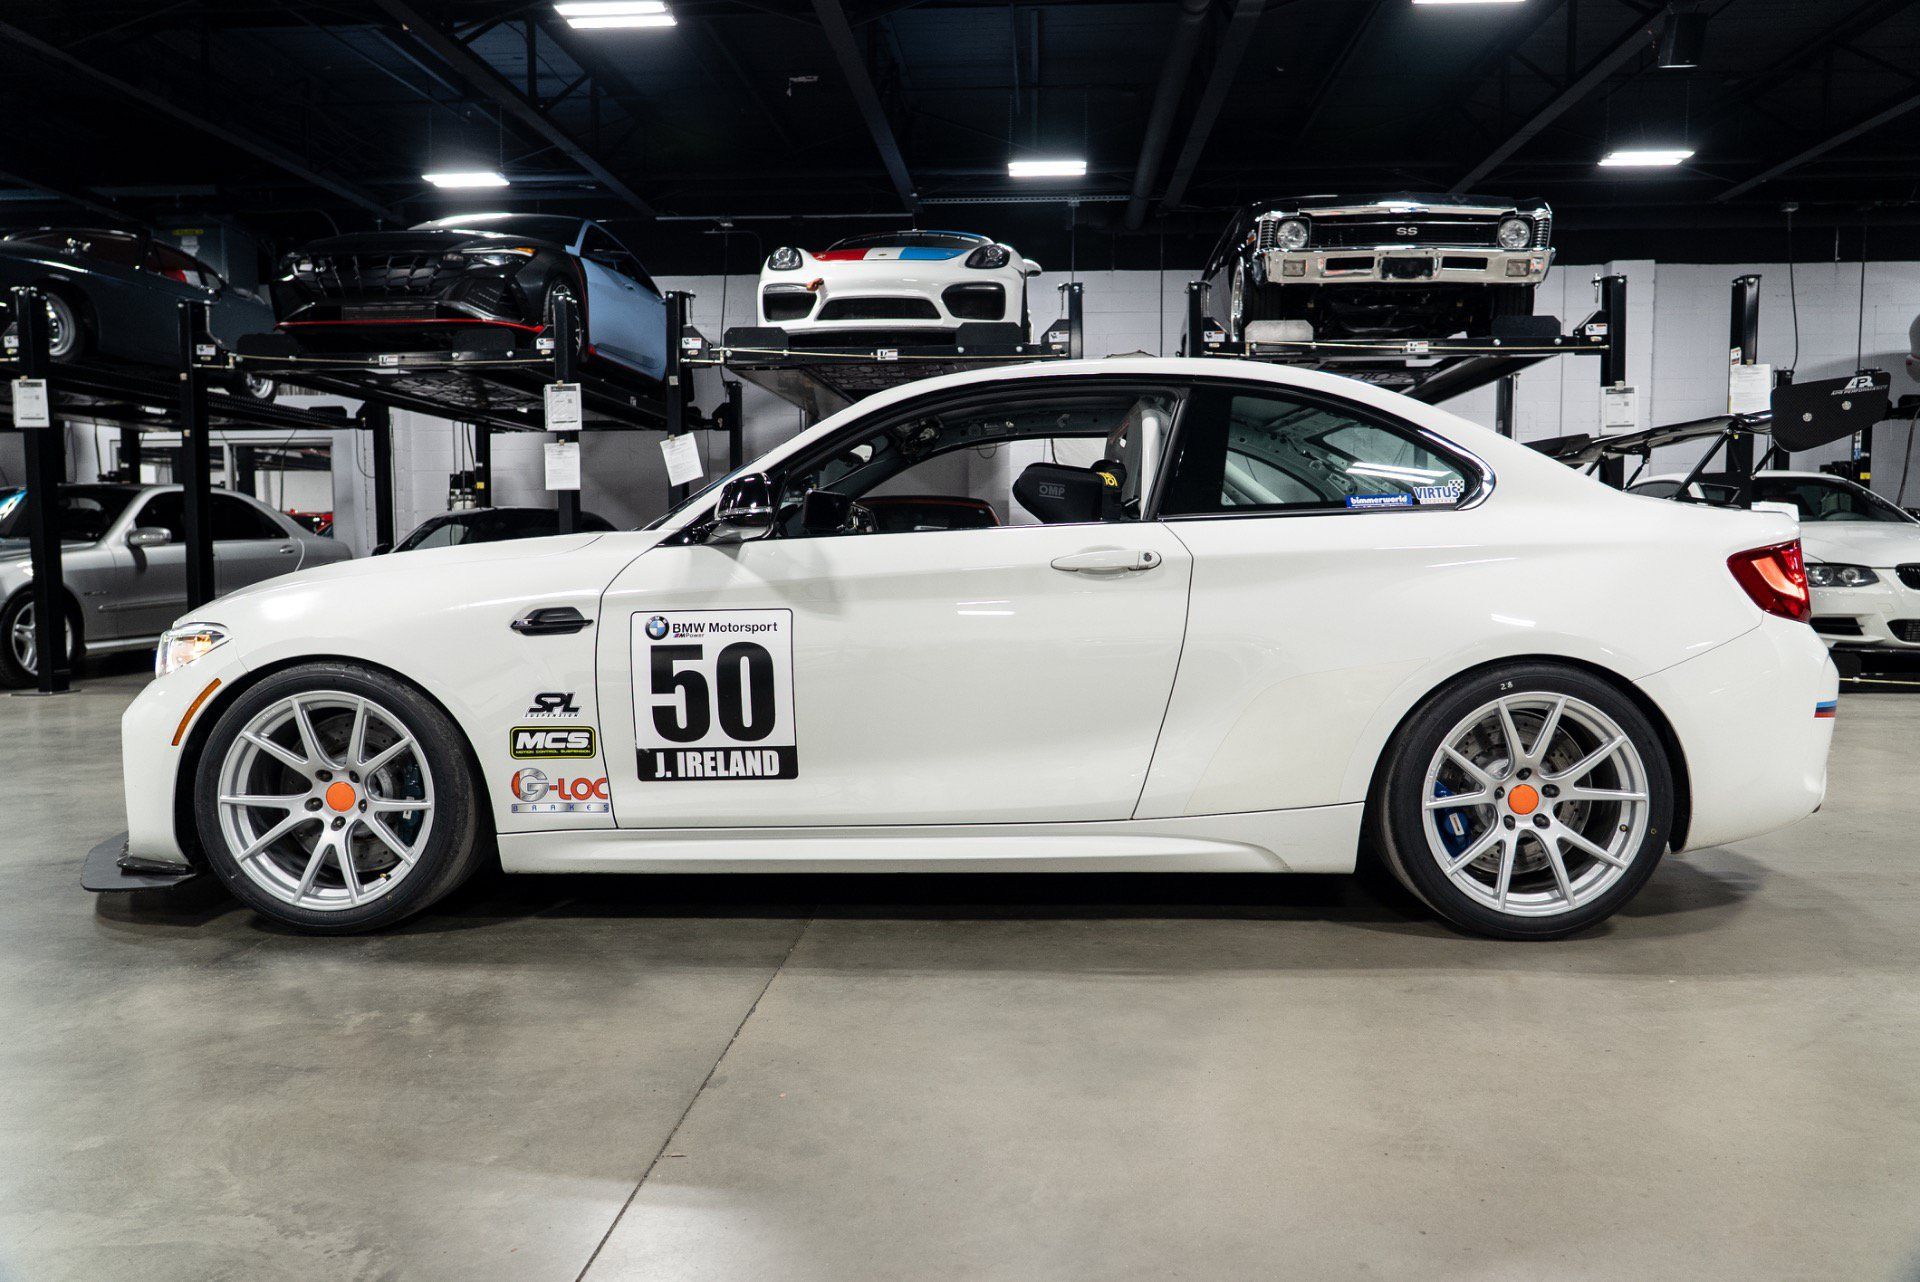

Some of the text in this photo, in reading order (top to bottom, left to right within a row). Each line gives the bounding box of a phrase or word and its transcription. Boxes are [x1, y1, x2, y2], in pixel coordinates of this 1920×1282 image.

[1396, 227, 1418, 236] SS
[1039, 485, 1065, 496] OMP
[1414, 486, 1459, 499] VIRTUS
[1350, 495, 1408, 504] bimmerworld
[672, 622, 778, 634] BMW Motorsport
[650, 641, 776, 743] 50
[528, 692, 580, 713] SPL
[515, 732, 591, 749] MCS
[655, 750, 780, 778] J. IRELAND
[511, 767, 608, 802] G-LOC
